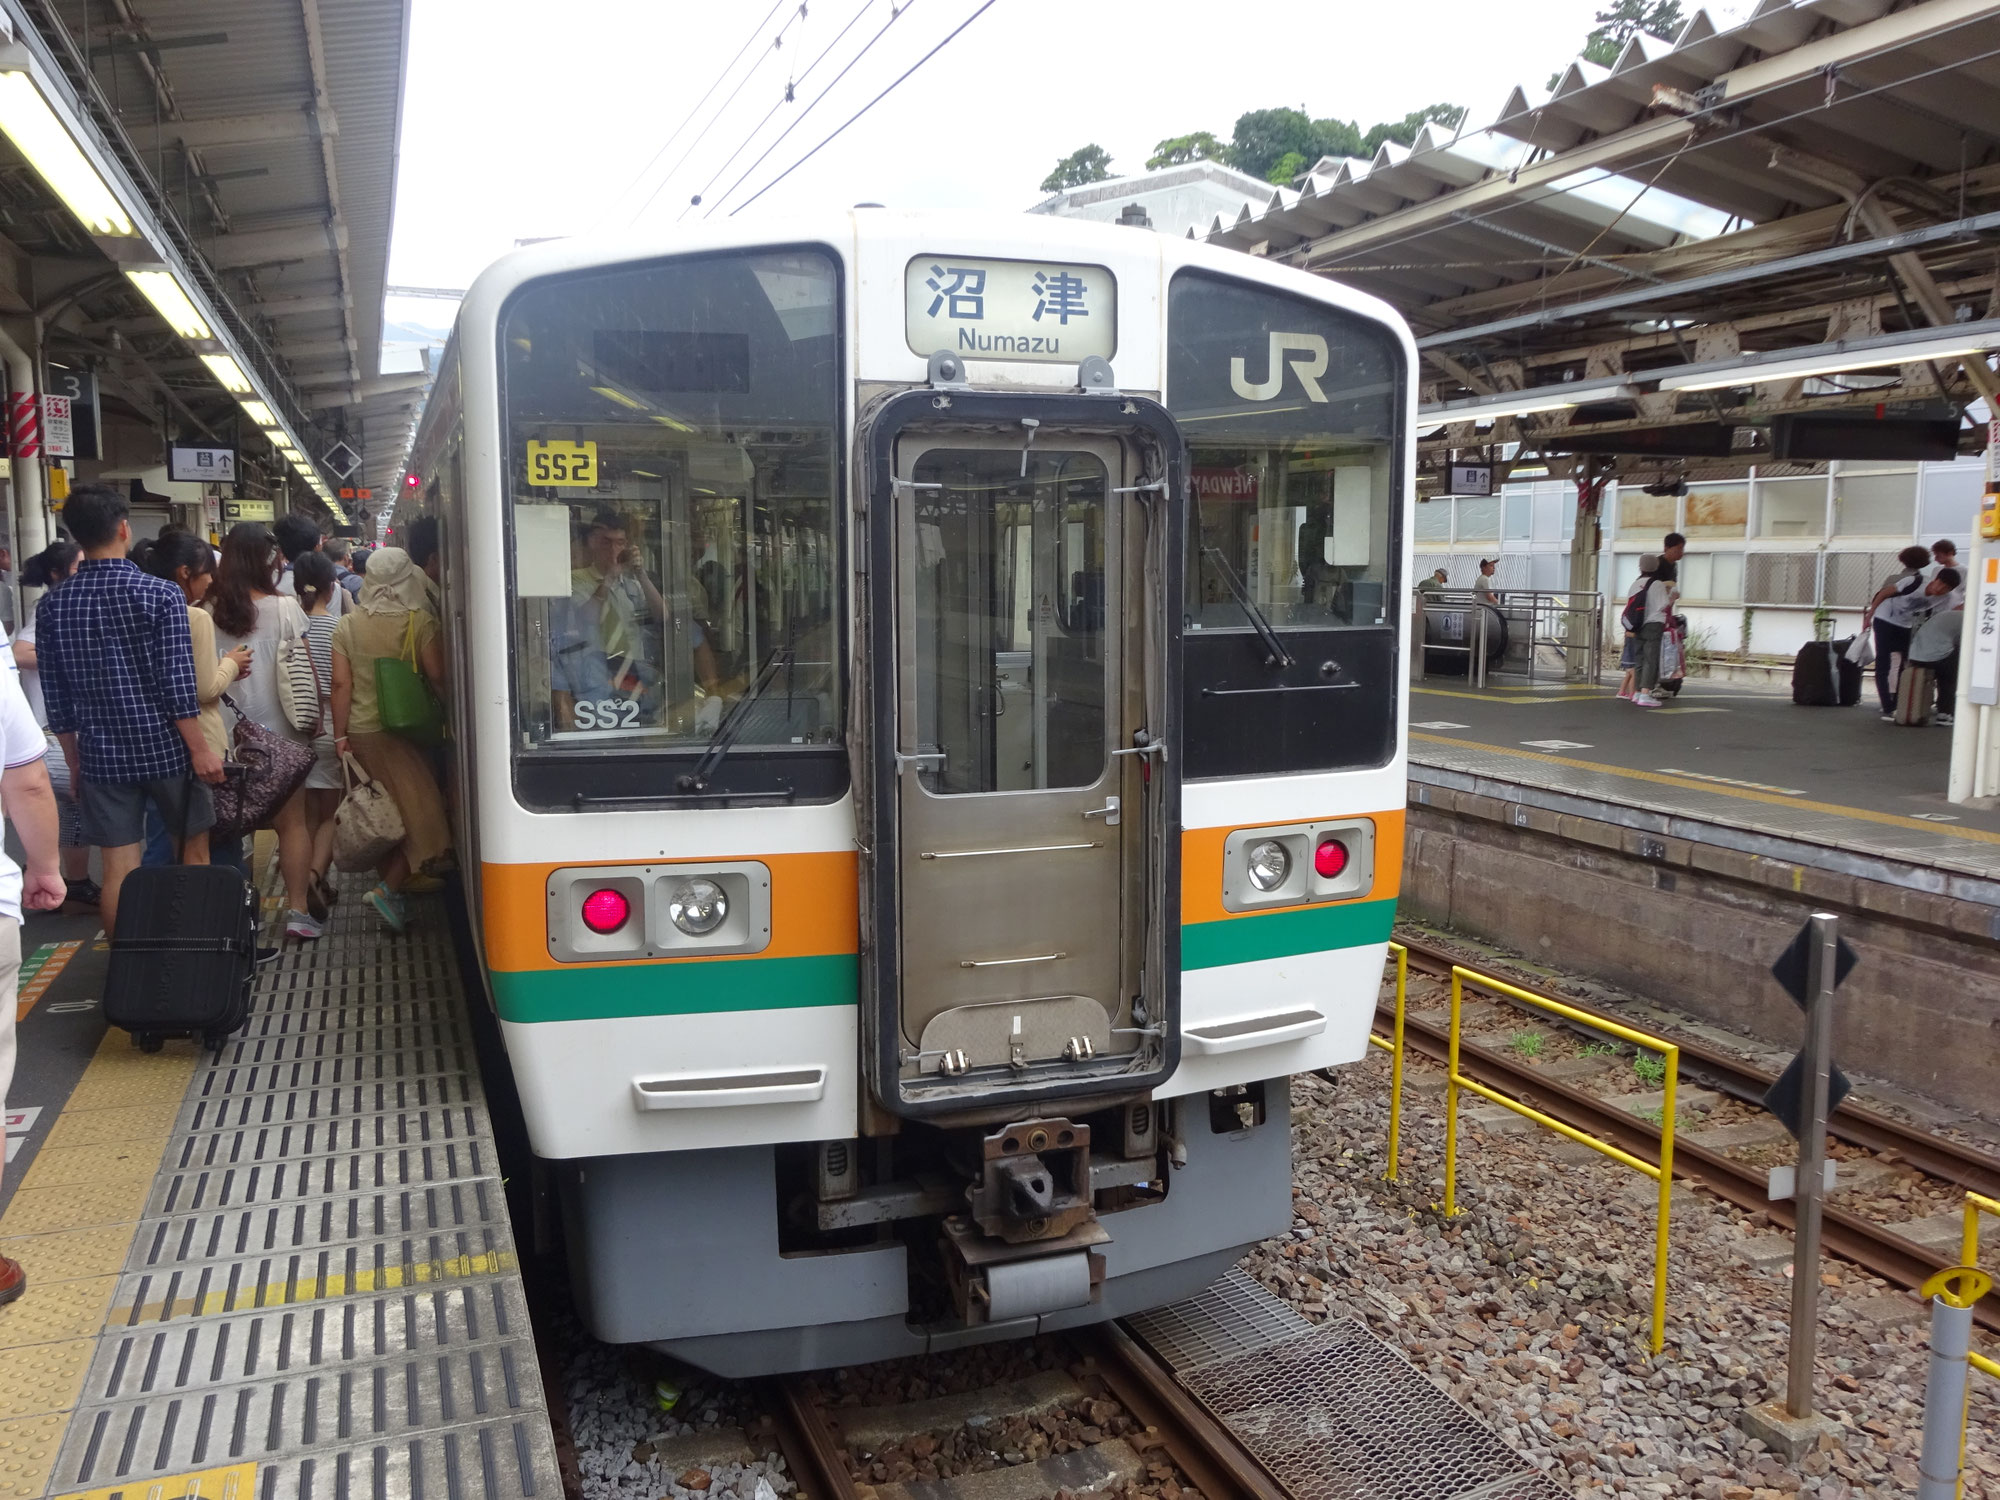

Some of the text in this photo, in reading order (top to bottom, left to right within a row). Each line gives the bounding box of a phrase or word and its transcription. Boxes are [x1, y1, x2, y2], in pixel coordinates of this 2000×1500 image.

[926, 264, 1089, 325] 沼津
[958, 328, 1060, 354] Numazu
[1230, 331, 1330, 403] JR
[63, 375, 81, 401] 3
[535, 453, 591, 482] SS2
[1981, 592, 1997, 635] あたみ
[574, 700, 640, 730] SS2
